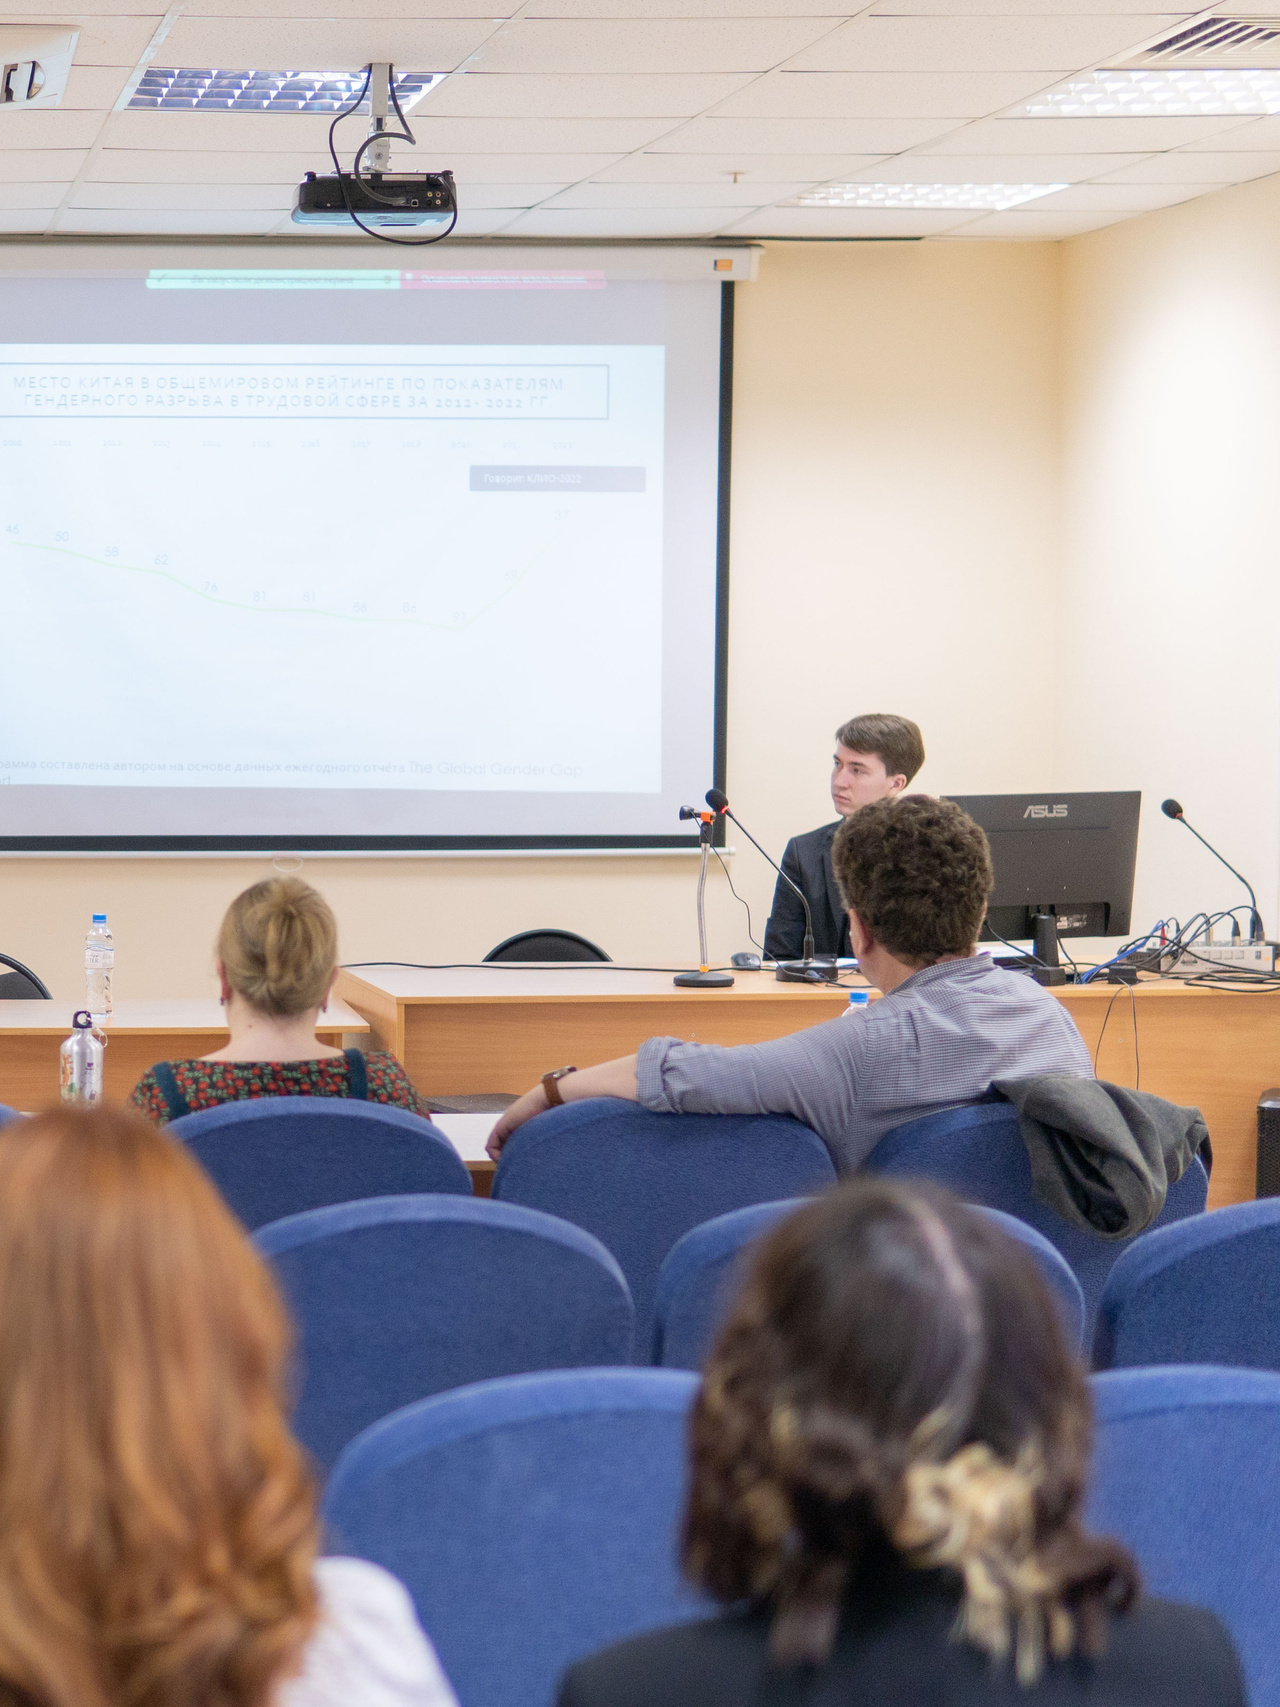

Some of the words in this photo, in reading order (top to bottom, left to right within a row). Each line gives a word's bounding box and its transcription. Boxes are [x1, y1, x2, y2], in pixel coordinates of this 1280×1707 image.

[13, 376, 71, 389] МЕСТО
[78, 376, 133, 389] КИТАЯ
[141, 377, 149, 389] В
[156, 377, 299, 391] ОБЩЕМИРОВОМ
[305, 374, 395, 390] РЕЙТИНГЕ
[402, 378, 426, 390] ПО
[433, 378, 564, 391] ПОКАЗАТЕЛЯМ
[24, 394, 138, 409] ГЕНДЕРНОГО
[145, 395, 223, 407] РАЗРЫВА
[231, 395, 239, 407] В
[247, 392, 339, 410] ТРУДОВОЙ
[345, 395, 401, 408] СФЕРЕ
[407, 395, 428, 407] ЗА
[486, 398, 523, 409] 2022
[527, 473, 582, 485] КЛИО-2022
[5, 524, 20, 535] 46
[55, 531, 70, 542] 50
[104, 547, 119, 558] 58
[154, 555, 169, 565] 62
[203, 582, 219, 592] 76
[253, 591, 266, 602] 81
[303, 591, 316, 602] 81
[40, 760, 110, 771] составлена
[113, 761, 166, 773] автором
[169, 762, 184, 772] на
[187, 762, 231, 772] основе
[234, 762, 281, 775] данных
[285, 762, 361, 775] ежегодного
[408, 760, 433, 774] The
[437, 761, 487, 775] Global
[490, 762, 546, 776] Gender
[550, 763, 584, 778] Gap
[1023, 804, 1068, 818] ASUS
